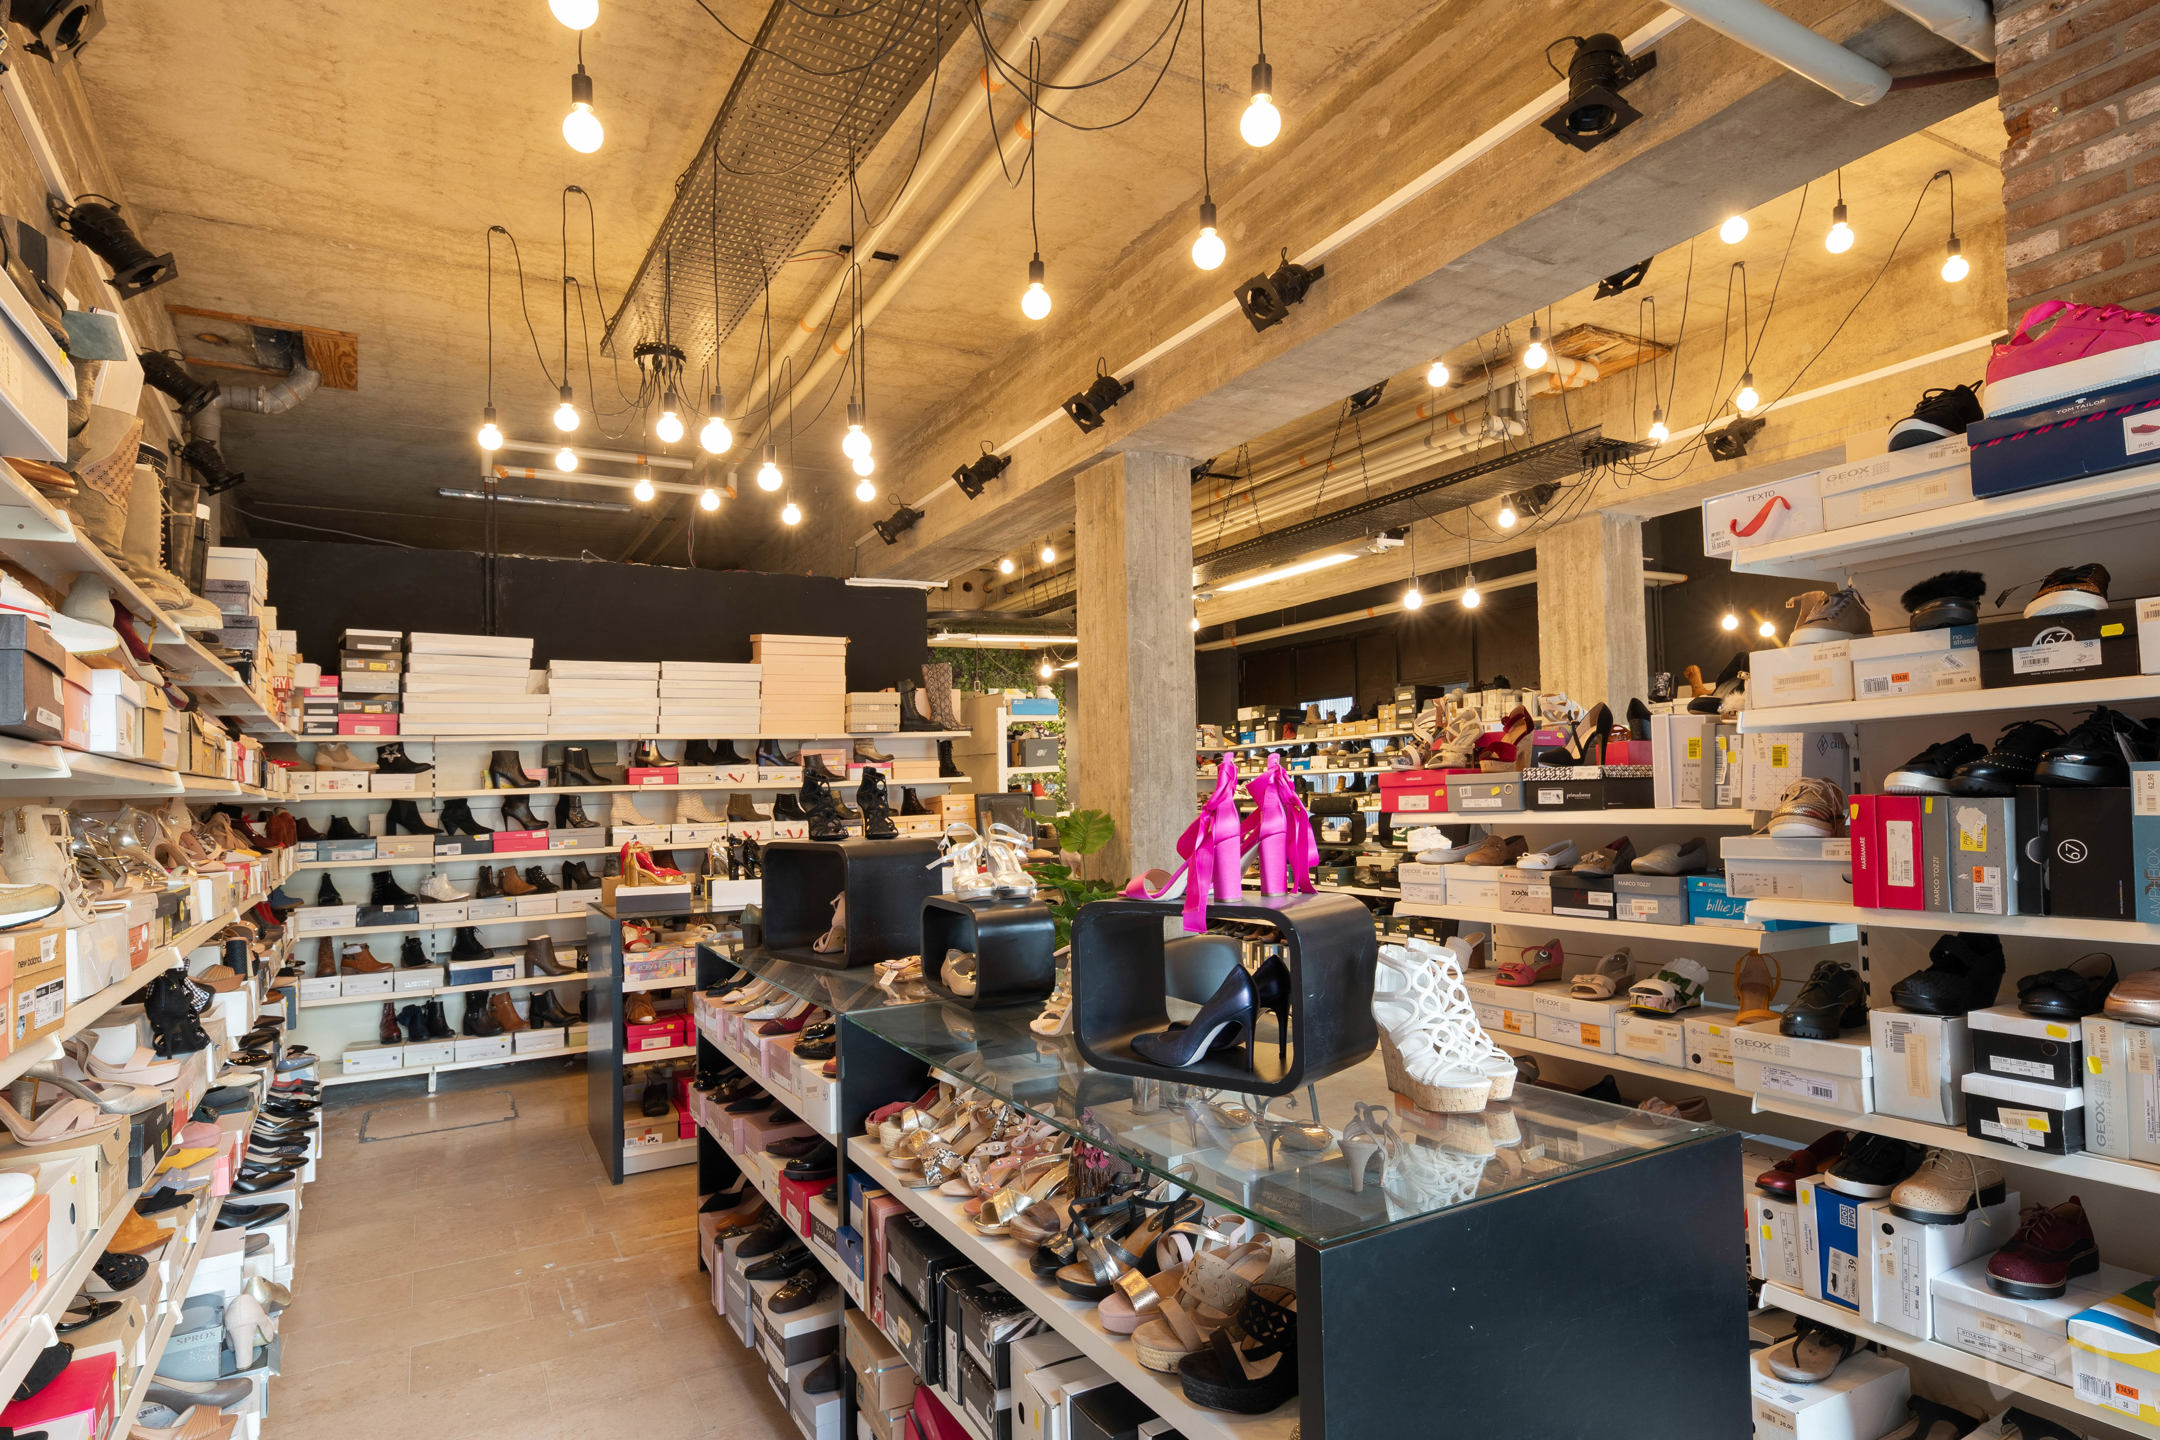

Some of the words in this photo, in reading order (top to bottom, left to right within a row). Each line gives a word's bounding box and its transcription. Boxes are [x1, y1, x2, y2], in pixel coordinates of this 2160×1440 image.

[2056, 405, 2074, 415] TOM
[2075, 398, 2106, 410] TAILOR
[1826, 464, 1869, 482] GEOX
[1746, 489, 1775, 503] TEXTO
[2064, 842, 2081, 860] 67
[1933, 878, 1941, 906] MARCO
[1706, 898, 1731, 912] billie
[17, 960, 26, 968] new
[1535, 997, 1560, 1007] GEOX
[1734, 1037, 1772, 1050] GEOX
[2095, 1099, 2107, 1147] GEOX
[1840, 1205, 1849, 1225] GIOS
[1848, 1207, 1856, 1227] EPPO
[1848, 1258, 1857, 1272] 39
